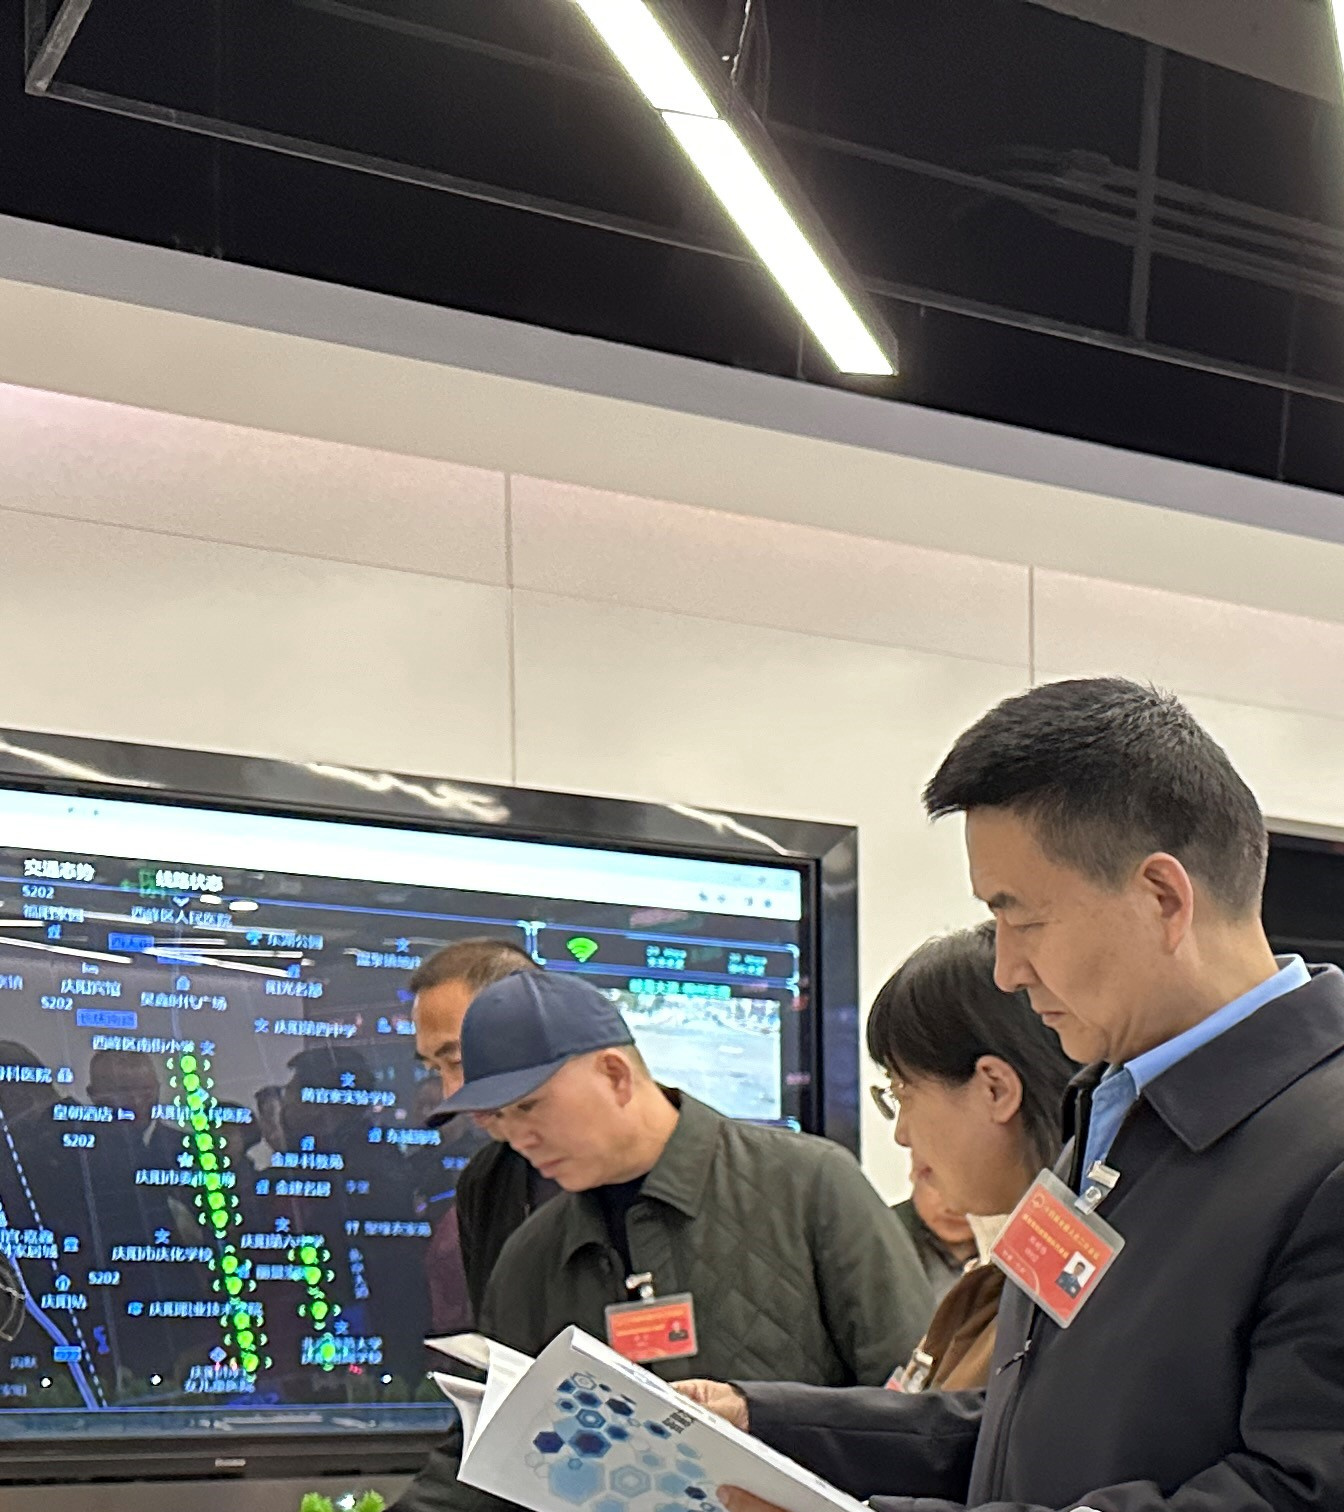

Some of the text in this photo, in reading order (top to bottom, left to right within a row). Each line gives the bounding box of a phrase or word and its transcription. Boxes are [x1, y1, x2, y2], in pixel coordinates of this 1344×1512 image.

[22, 885, 55, 899] S202
[41, 996, 73, 1010] S202
[0, 1065, 52, 1084] 科医院
[151, 1104, 253, 1124] 庆阳市民医院
[62, 1134, 96, 1149] S202
[88, 1271, 121, 1285] S202
[149, 1301, 264, 1317] 庆阳职业技术院
